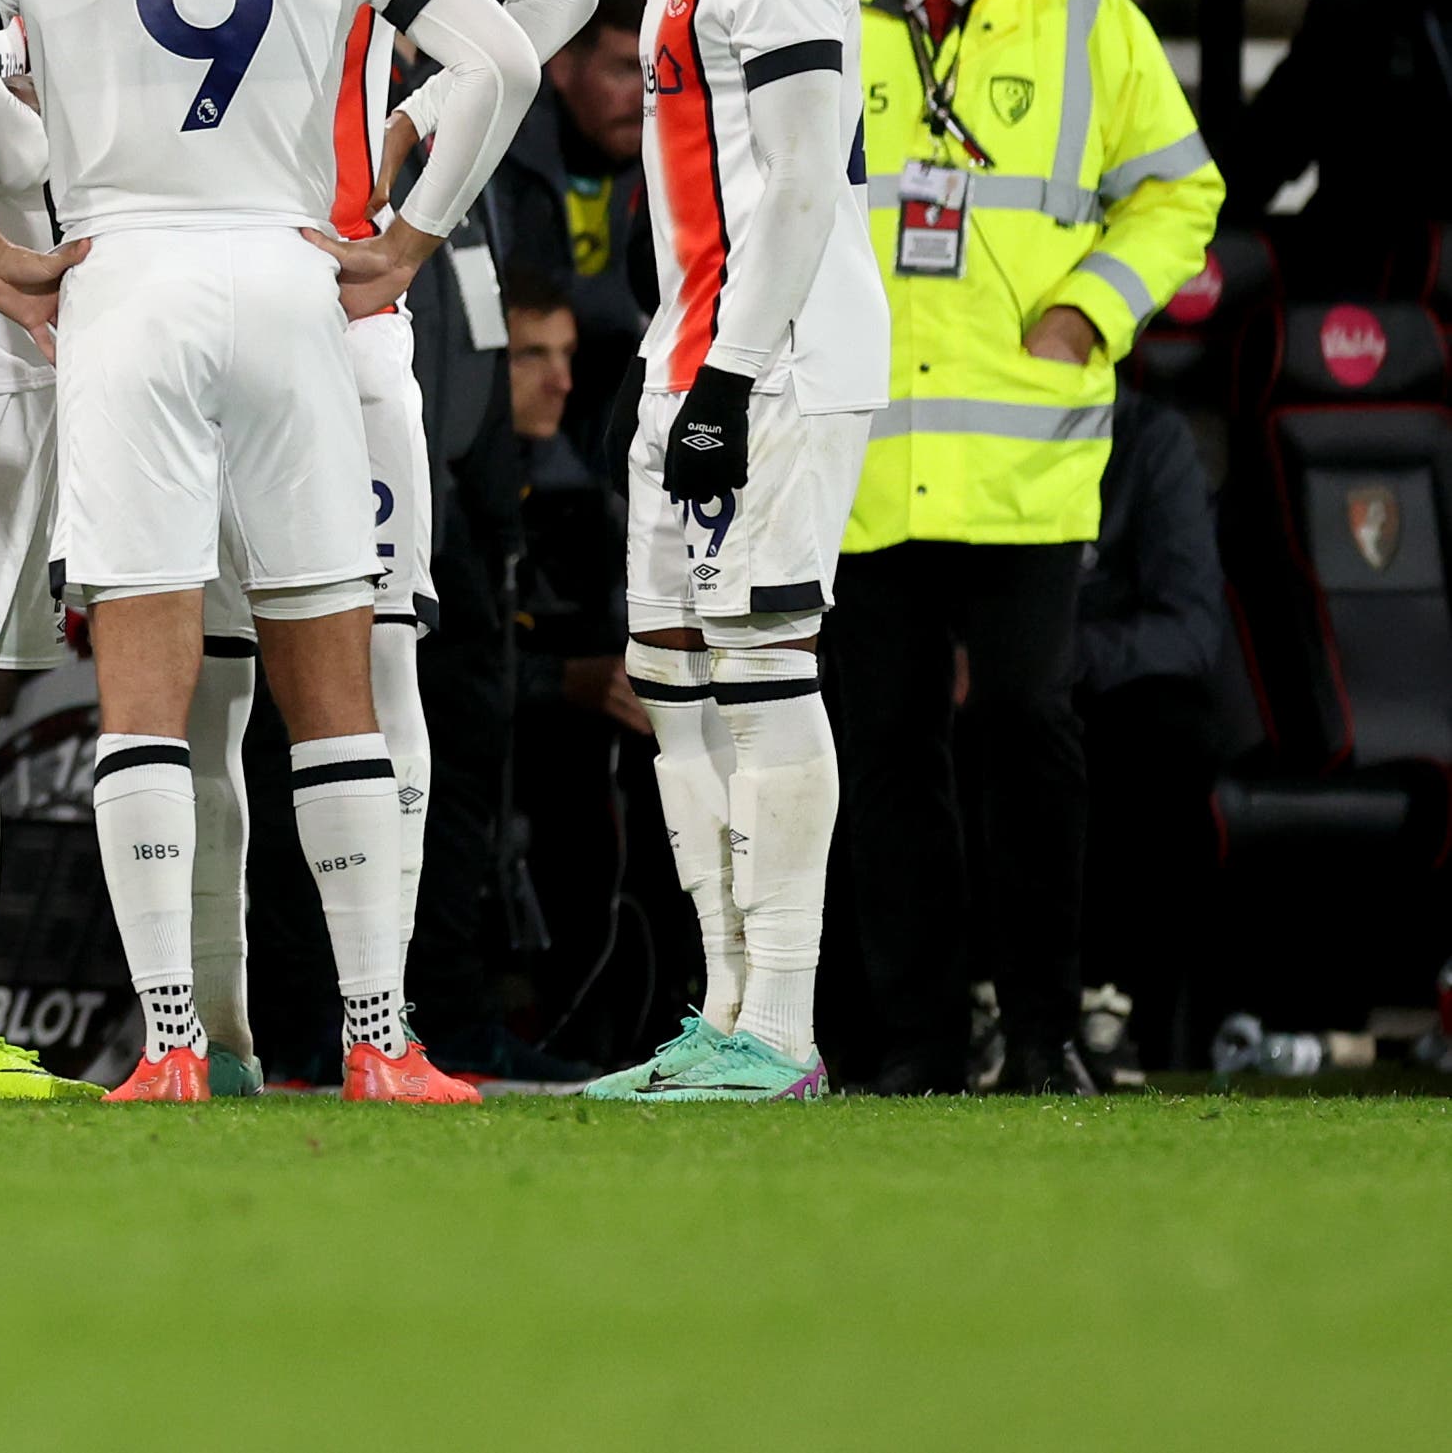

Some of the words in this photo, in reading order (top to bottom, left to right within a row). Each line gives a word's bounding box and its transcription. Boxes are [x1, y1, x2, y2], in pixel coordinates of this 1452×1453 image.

[687, 421, 723, 435] umbro
[670, 490, 737, 559] 9
[132, 844, 180, 861] 1885
[315, 852, 367, 874] 1885
